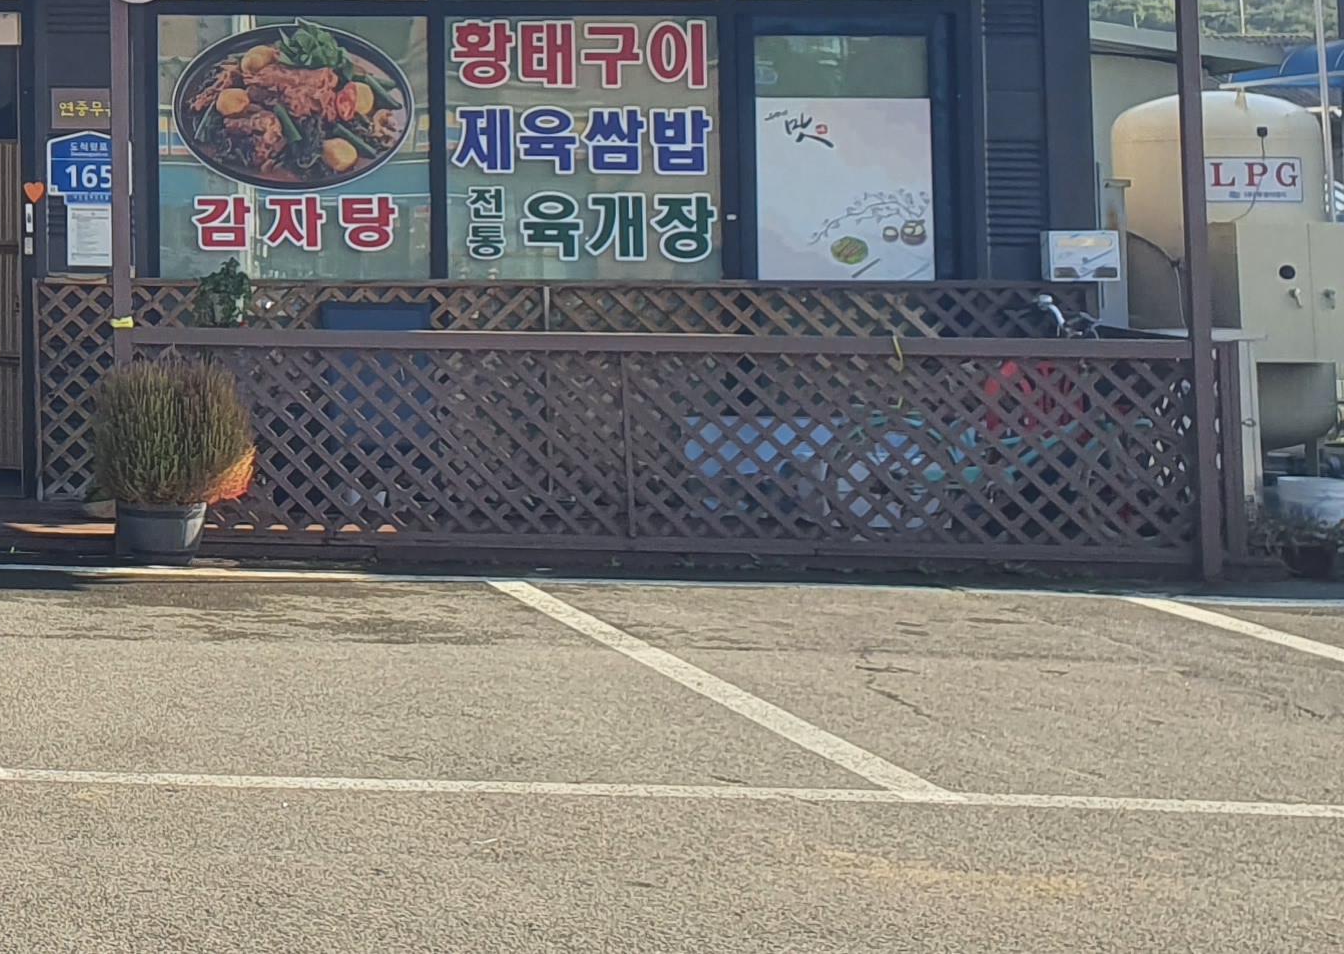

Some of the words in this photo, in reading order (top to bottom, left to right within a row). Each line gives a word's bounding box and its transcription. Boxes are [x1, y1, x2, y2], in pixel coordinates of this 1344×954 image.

[450, 20, 709, 90] 황태구이
[58, 100, 111, 118] 연중무
[451, 106, 710, 175] 제육쌈밥
[64, 164, 112, 189] 165
[1209, 161, 1299, 188] LPG
[192, 194, 399, 252] 감자탕
[466, 186, 505, 260] 전통
[522, 192, 716, 262] 육개장
